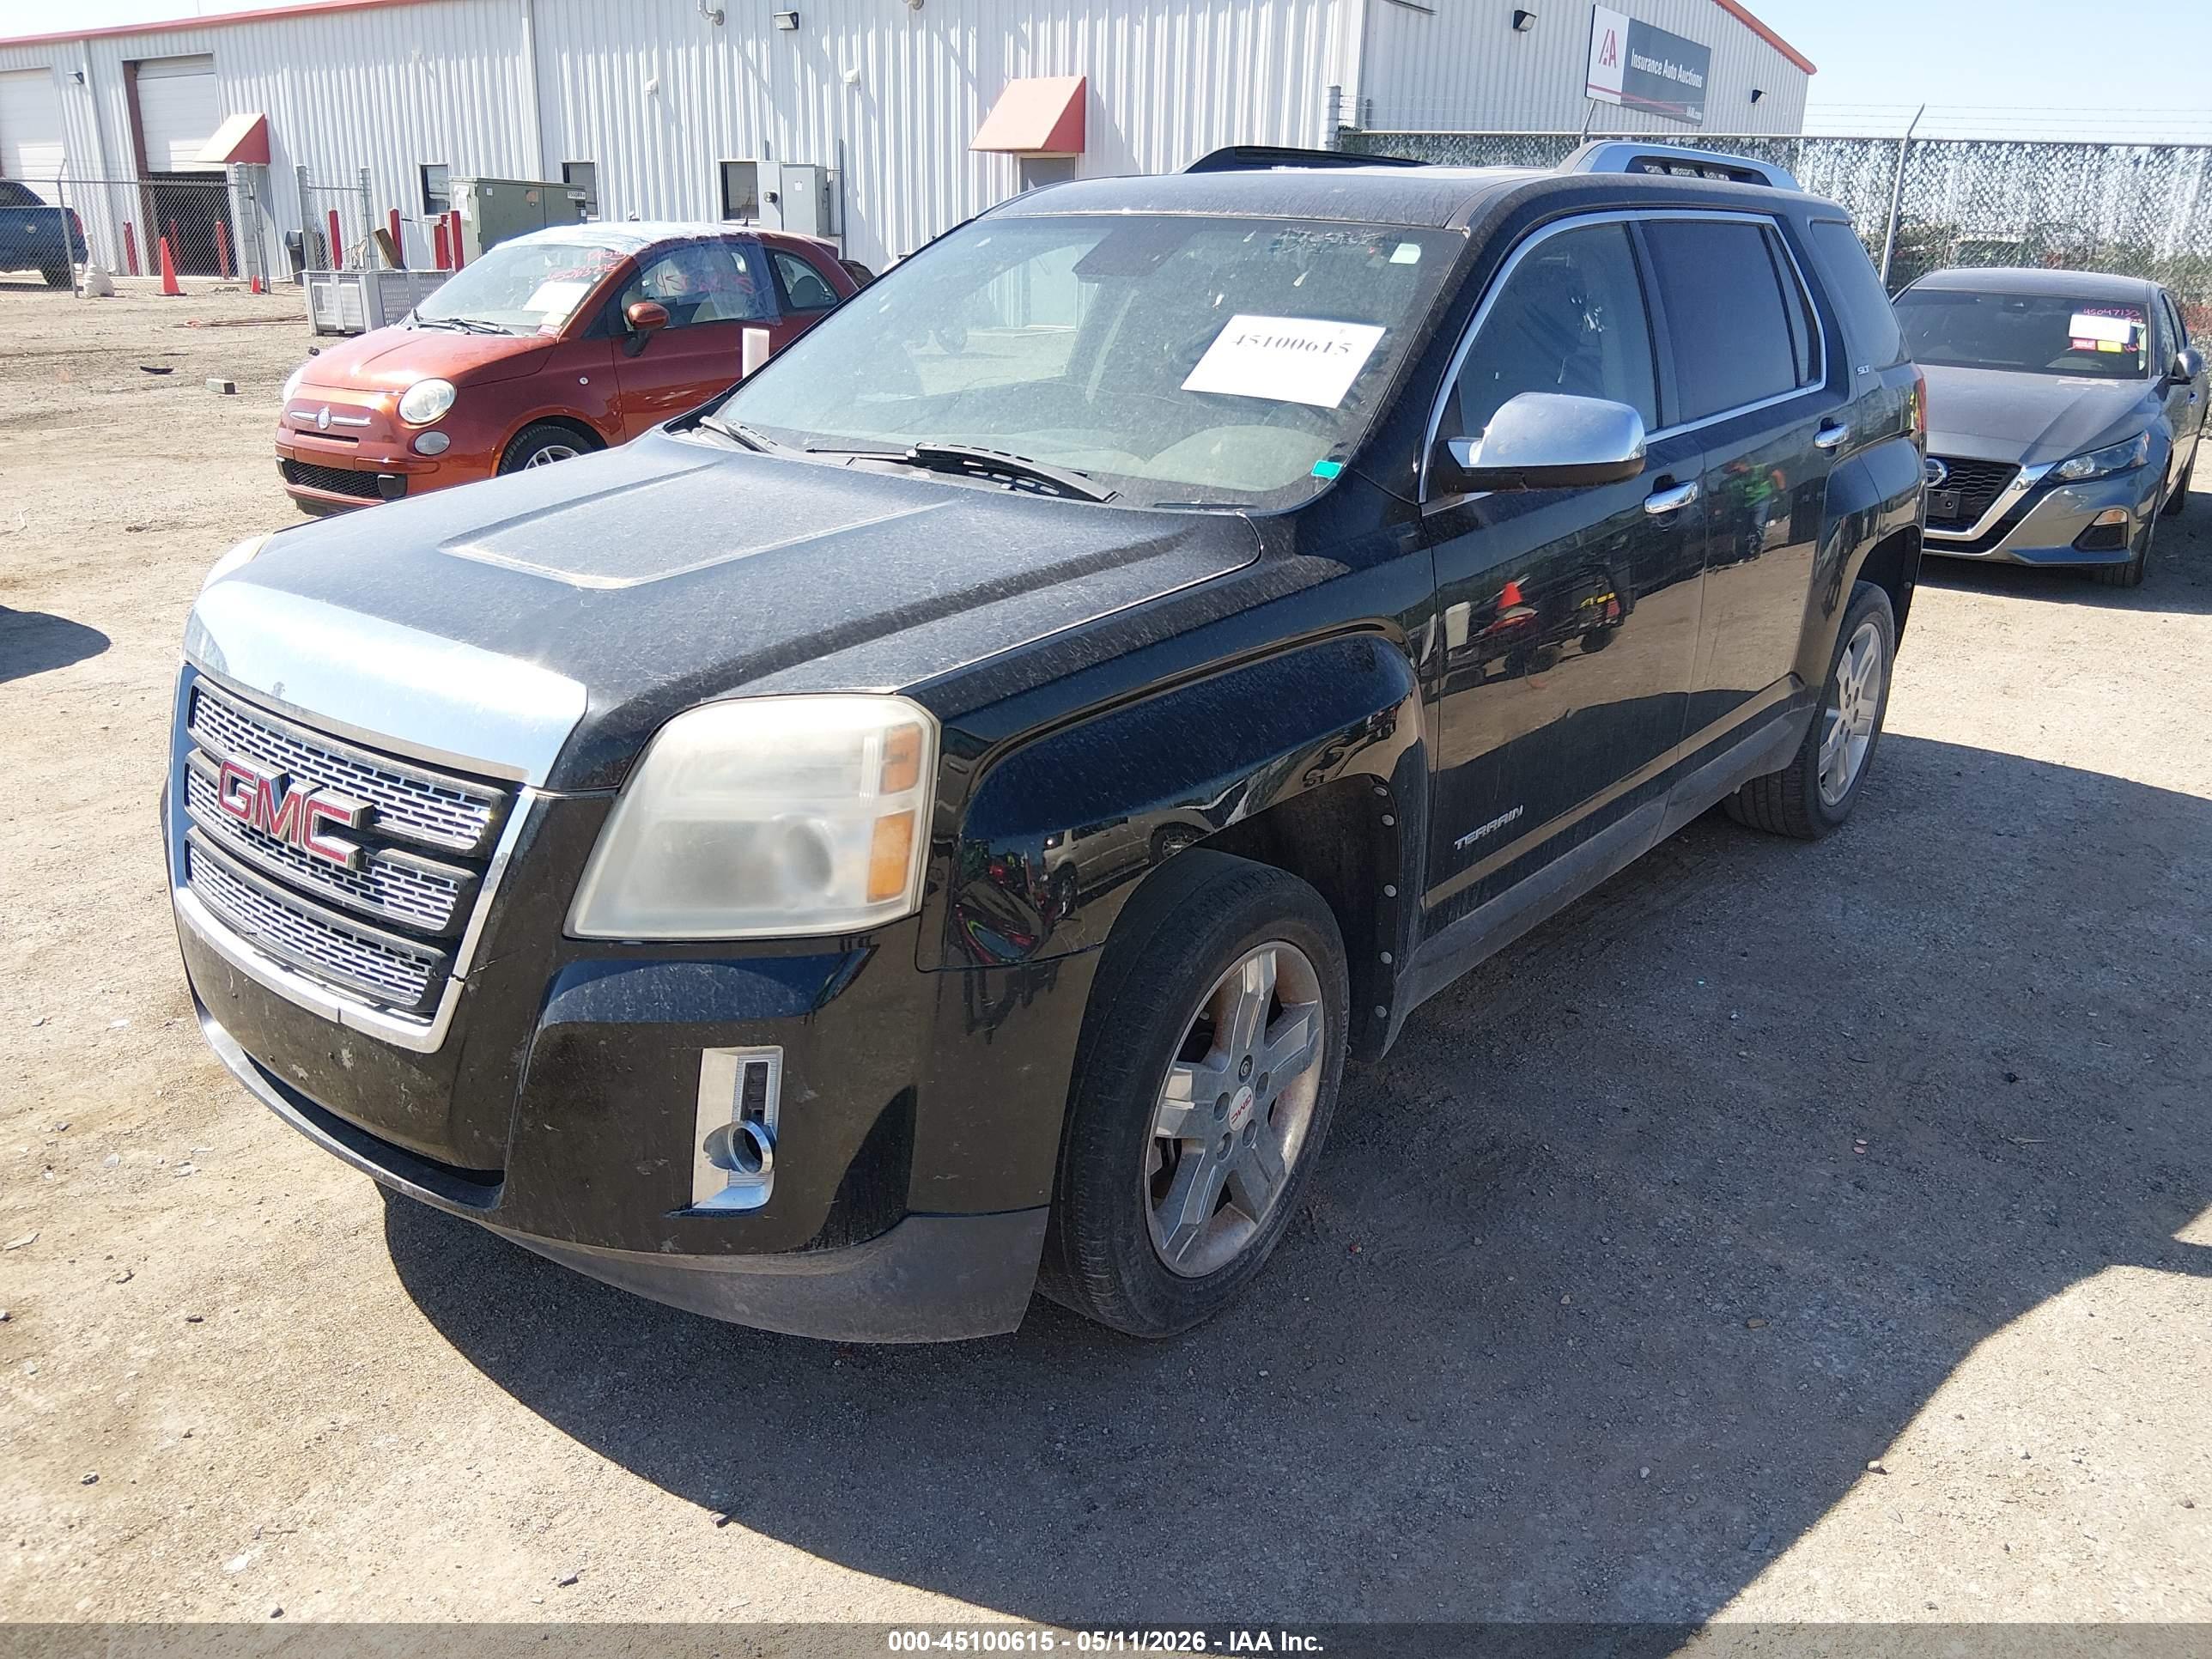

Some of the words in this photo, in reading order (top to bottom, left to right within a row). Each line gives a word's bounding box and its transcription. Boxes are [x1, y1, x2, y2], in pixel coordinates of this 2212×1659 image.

[1632, 48, 1662, 76] Insurance
[1662, 59, 1677, 81] Auto
[1677, 64, 1704, 89] Auctions
[1231, 334, 1352, 356] 45100615
[219, 756, 361, 868] GMC
[1454, 805, 1524, 850] TERRAIN
[1231, 1093, 1252, 1125] GMC
